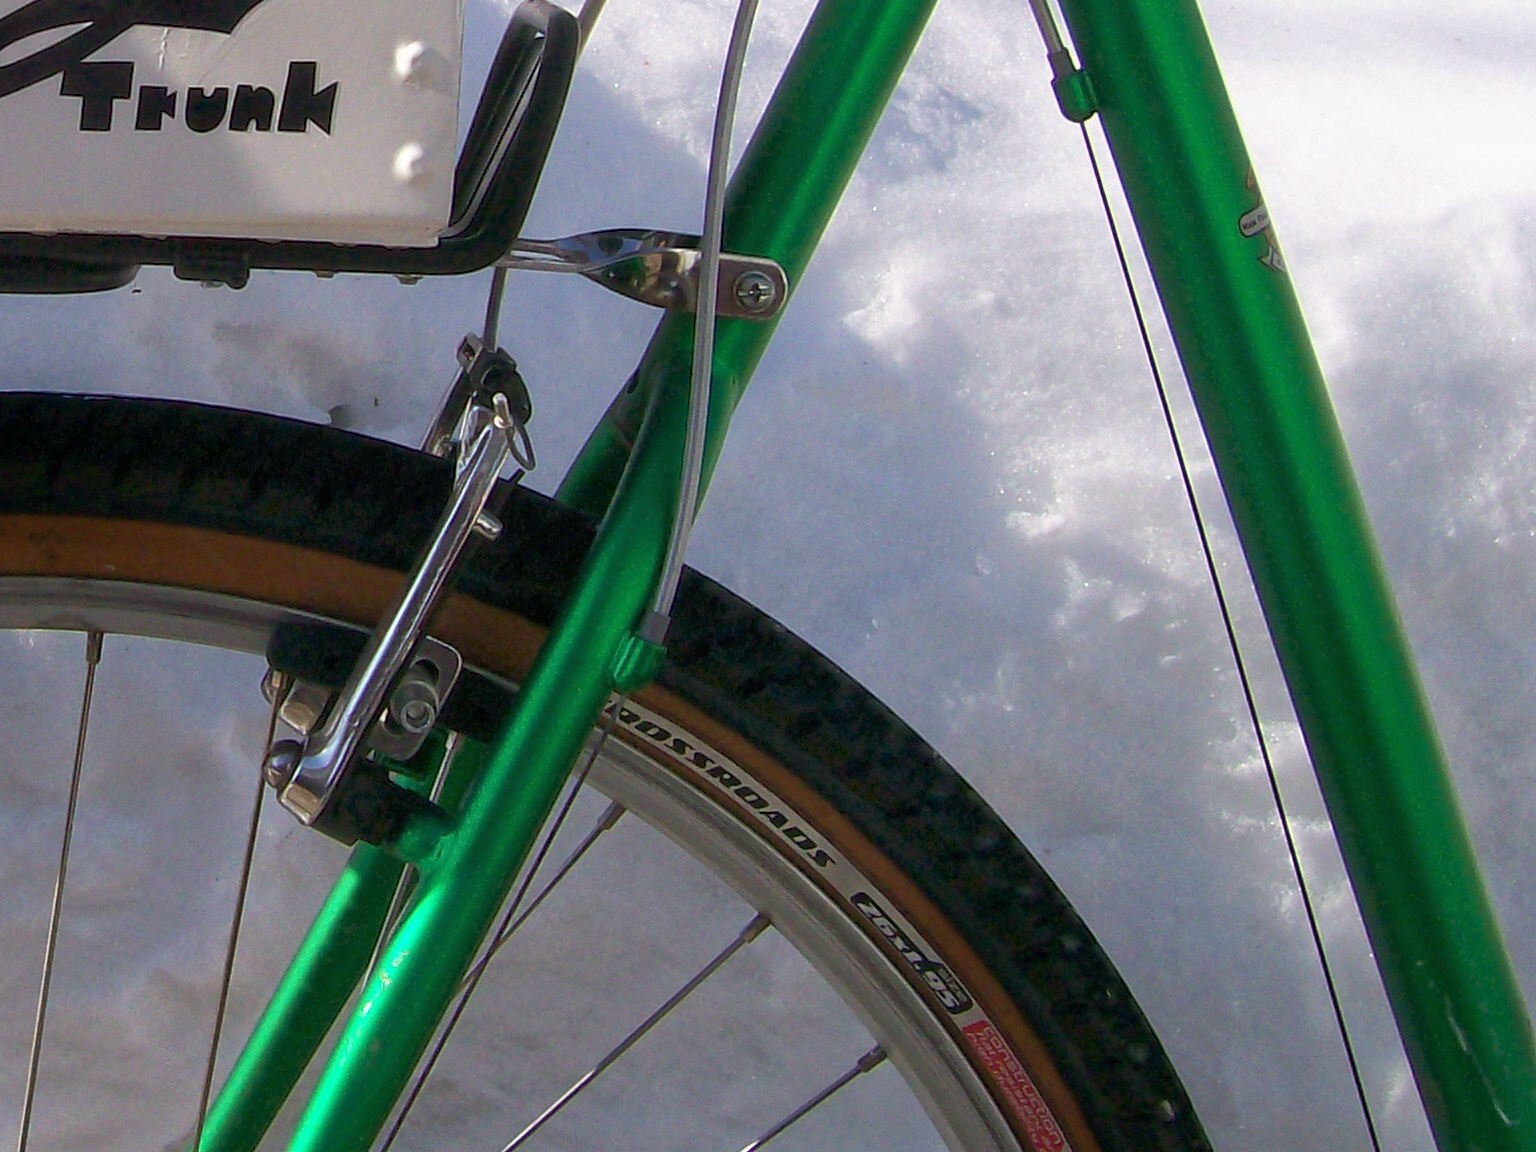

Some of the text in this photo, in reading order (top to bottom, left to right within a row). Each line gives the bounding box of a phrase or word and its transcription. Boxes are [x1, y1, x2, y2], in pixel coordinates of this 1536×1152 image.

[60, 61, 340, 136] Trunk
[603, 705, 835, 868] ROSSROADS
[855, 899, 960, 1009] 26x1.95
